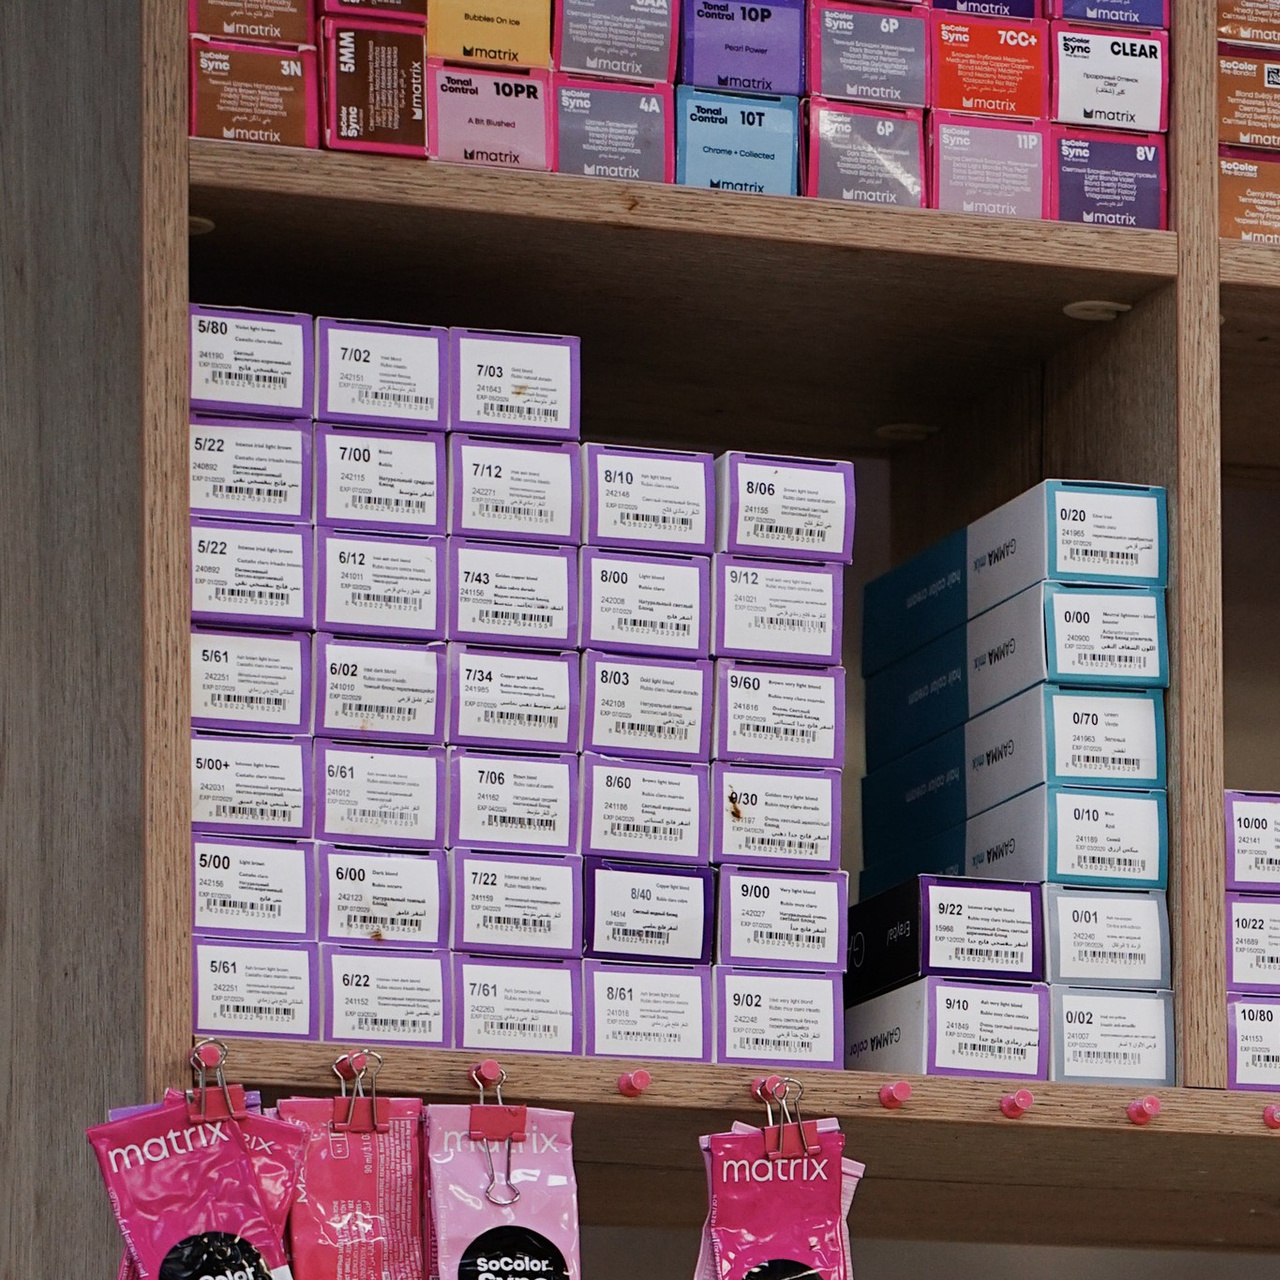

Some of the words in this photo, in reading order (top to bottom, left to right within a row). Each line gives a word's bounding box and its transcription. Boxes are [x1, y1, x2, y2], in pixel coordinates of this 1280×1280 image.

[703, 2, 728, 12] Tonal
[740, 6, 771, 22] 10P
[464, 13, 494, 23] Bubbles
[496, 16, 507, 24] On
[697, 10, 734, 21] Control
[880, 18, 899, 33] 6P
[941, 31, 969, 43] Sync
[998, 31, 1037, 46] 7CC+
[339, 32, 355, 73] 5MM
[475, 48, 519, 62] matrix
[745, 46, 768, 54] Power
[1063, 43, 1090, 54] Sync
[1110, 41, 1158, 59] CLEAR
[200, 59, 230, 71] Sync
[281, 60, 302, 76] 3N
[1220, 61, 1257, 71] SoColor
[445, 76, 472, 86] Tonal
[441, 84, 479, 95] Control
[494, 82, 538, 99] 10PR
[561, 96, 591, 109] Sync
[639, 97, 660, 113] 4A
[695, 105, 721, 115] Tonal
[486, 119, 515, 128] Blushed
[690, 113, 727, 124] Control
[740, 111, 765, 126] 10T
[876, 121, 894, 136] 6P
[476, 151, 520, 164] matrix
[703, 146, 732, 155] Chrome
[739, 150, 775, 160] Collected
[1061, 146, 1089, 157] Sync
[1136, 146, 1155, 161] 8V
[198, 320, 227, 335] 5/80
[340, 347, 370, 363] 7/02
[340, 373, 364, 381] 242151
[477, 365, 503, 378] 7/03
[194, 438, 224, 452] 5/22
[339, 447, 370, 462] 7/00
[341, 473, 365, 481] 242115
[472, 464, 502, 479] 7/12
[604, 470, 633, 485] 8/10
[746, 481, 775, 496] 8/06
[1060, 508, 1086, 522] 0/20
[198, 541, 227, 555] 5/22
[339, 552, 365, 566] 6/12
[341, 572, 363, 580] 241011
[463, 572, 490, 585] 7/43
[601, 570, 628, 584] 8/00
[730, 571, 759, 585] 9/12
[1064, 611, 1090, 624] 0/00
[202, 650, 228, 663] 5/61
[330, 663, 358, 676] 6/02
[465, 669, 493, 682] 7/34
[601, 671, 629, 685] 8/03
[730, 675, 760, 691] 9/60
[1072, 712, 1098, 726] 0/70
[195, 758, 230, 771] 5/00+
[327, 765, 355, 779] 6/61
[478, 770, 505, 786] 7/06
[606, 776, 631, 789] 8/60
[730, 792, 757, 806] 9/30
[1073, 808, 1099, 821] 0/10
[1237, 817, 1267, 830] 10/00
[1238, 836, 1260, 844] 242141
[199, 854, 230, 870] 5/00
[336, 867, 366, 882] 6/00
[471, 872, 497, 886] 7/22
[631, 888, 651, 900] 8/40
[741, 884, 770, 899] 9/00
[610, 910, 626, 918] 14514
[938, 903, 963, 916] 9/22
[1072, 910, 1098, 924] 0/01
[1235, 918, 1264, 930] 10/22
[210, 961, 237, 974] 5/61
[342, 974, 370, 988] 6/22
[469, 982, 498, 998] 7/61
[607, 987, 633, 1001] 8/61
[733, 994, 762, 1007] 9/02
[945, 999, 969, 1011] 9/10
[1066, 1011, 1093, 1025] 0/02
[1241, 1009, 1273, 1022] 10/80
[870, 1027, 901, 1051] GAMMA
[1067, 1032, 1089, 1040] 241007
[109, 1122, 229, 1172] matrix
[722, 1157, 828, 1183] matrix
[476, 1257, 548, 1272] SoColor
